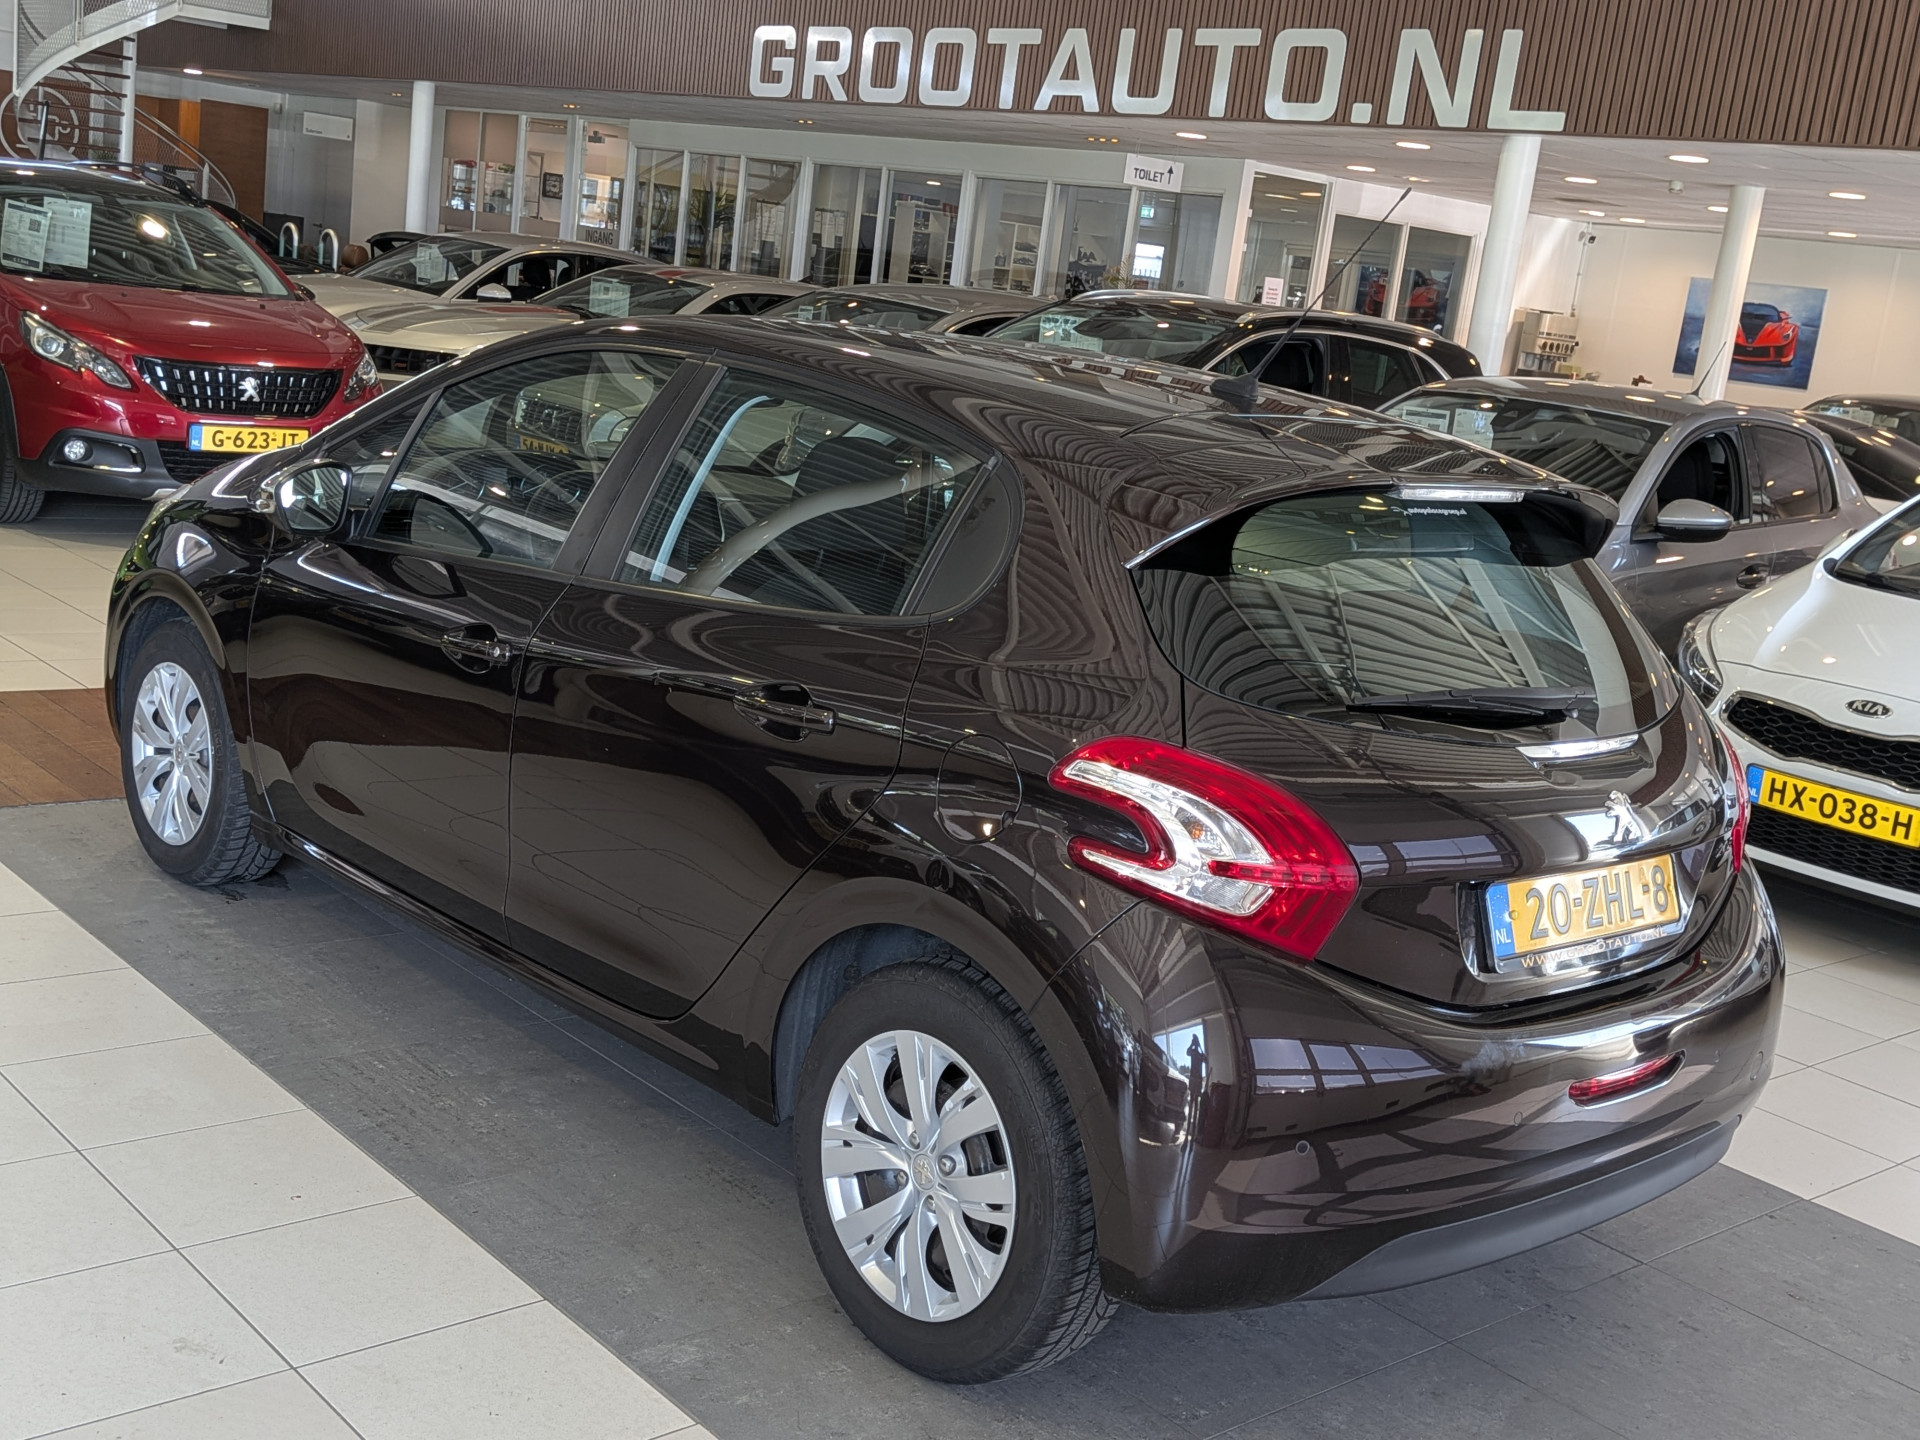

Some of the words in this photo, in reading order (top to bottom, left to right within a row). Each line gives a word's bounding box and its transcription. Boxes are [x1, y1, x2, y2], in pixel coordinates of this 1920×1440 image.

[749, 25, 1566, 132] GROOTAUTO.NL
[1134, 167, 1165, 183] TOILET
[585, 229, 614, 245] INGANG
[212, 429, 299, 449] G-623-JT
[1851, 699, 1885, 715] KIA
[1767, 777, 1913, 840] HX-038-H
[1525, 865, 1669, 940] 20-ZHL-8
[1495, 928, 1511, 945] NL
